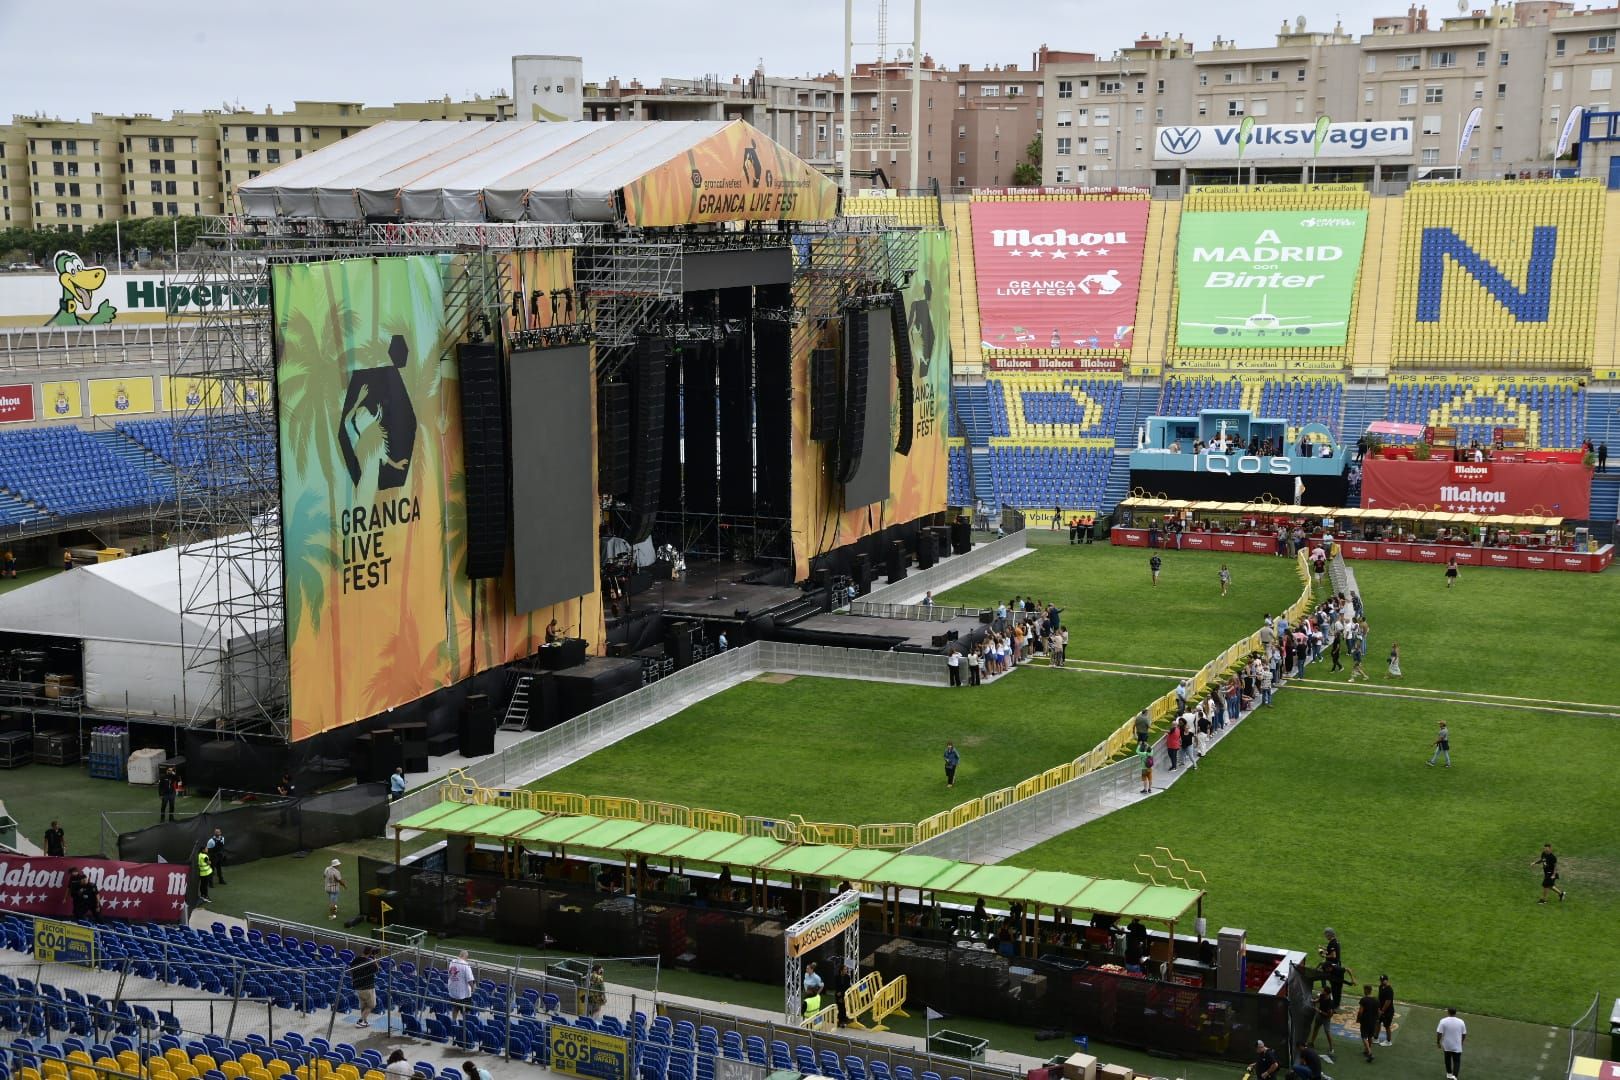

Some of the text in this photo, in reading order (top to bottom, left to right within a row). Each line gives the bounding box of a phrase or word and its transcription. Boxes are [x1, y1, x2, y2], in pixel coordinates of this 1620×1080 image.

[1214, 125, 1408, 149] Volkswagen
[972, 188, 1003, 196] Mahou
[1007, 187, 1039, 196] Mahou
[1045, 187, 1077, 195] Mahou
[1080, 186, 1112, 195] Mahou
[1118, 186, 1150, 195] Mahou
[698, 192, 798, 214] GRANCA LIVE FEST
[990, 229, 1128, 247] Mahou
[1255, 229, 1282, 244] A
[1193, 245, 1343, 262] MADRID
[1009, 280, 1076, 289] GRANCA
[1204, 271, 1326, 288] Binter
[997, 288, 1076, 296] LIVE FEST
[996, 358, 1032, 368] Mahou
[1039, 358, 1074, 368] Mahou
[1080, 358, 1116, 368] Mahou
[913, 383, 935, 403] ANCA
[0, 397, 20, 406] hou
[920, 400, 934, 420] LIVE
[916, 419, 935, 440] FEST
[1193, 454, 1291, 476] IQOS
[1455, 465, 1488, 474] Mahou
[1440, 486, 1506, 503] Mahou
[342, 496, 421, 536] GRANCA
[1030, 513, 1065, 521] Volk
[343, 531, 385, 565] LIVE
[343, 557, 392, 594] FEST
[82, 866, 155, 894] Mahou
[42, 923, 65, 934] SECTOR
[802, 921, 832, 948] ACCESO
[560, 1031, 589, 1043] SECTOR
